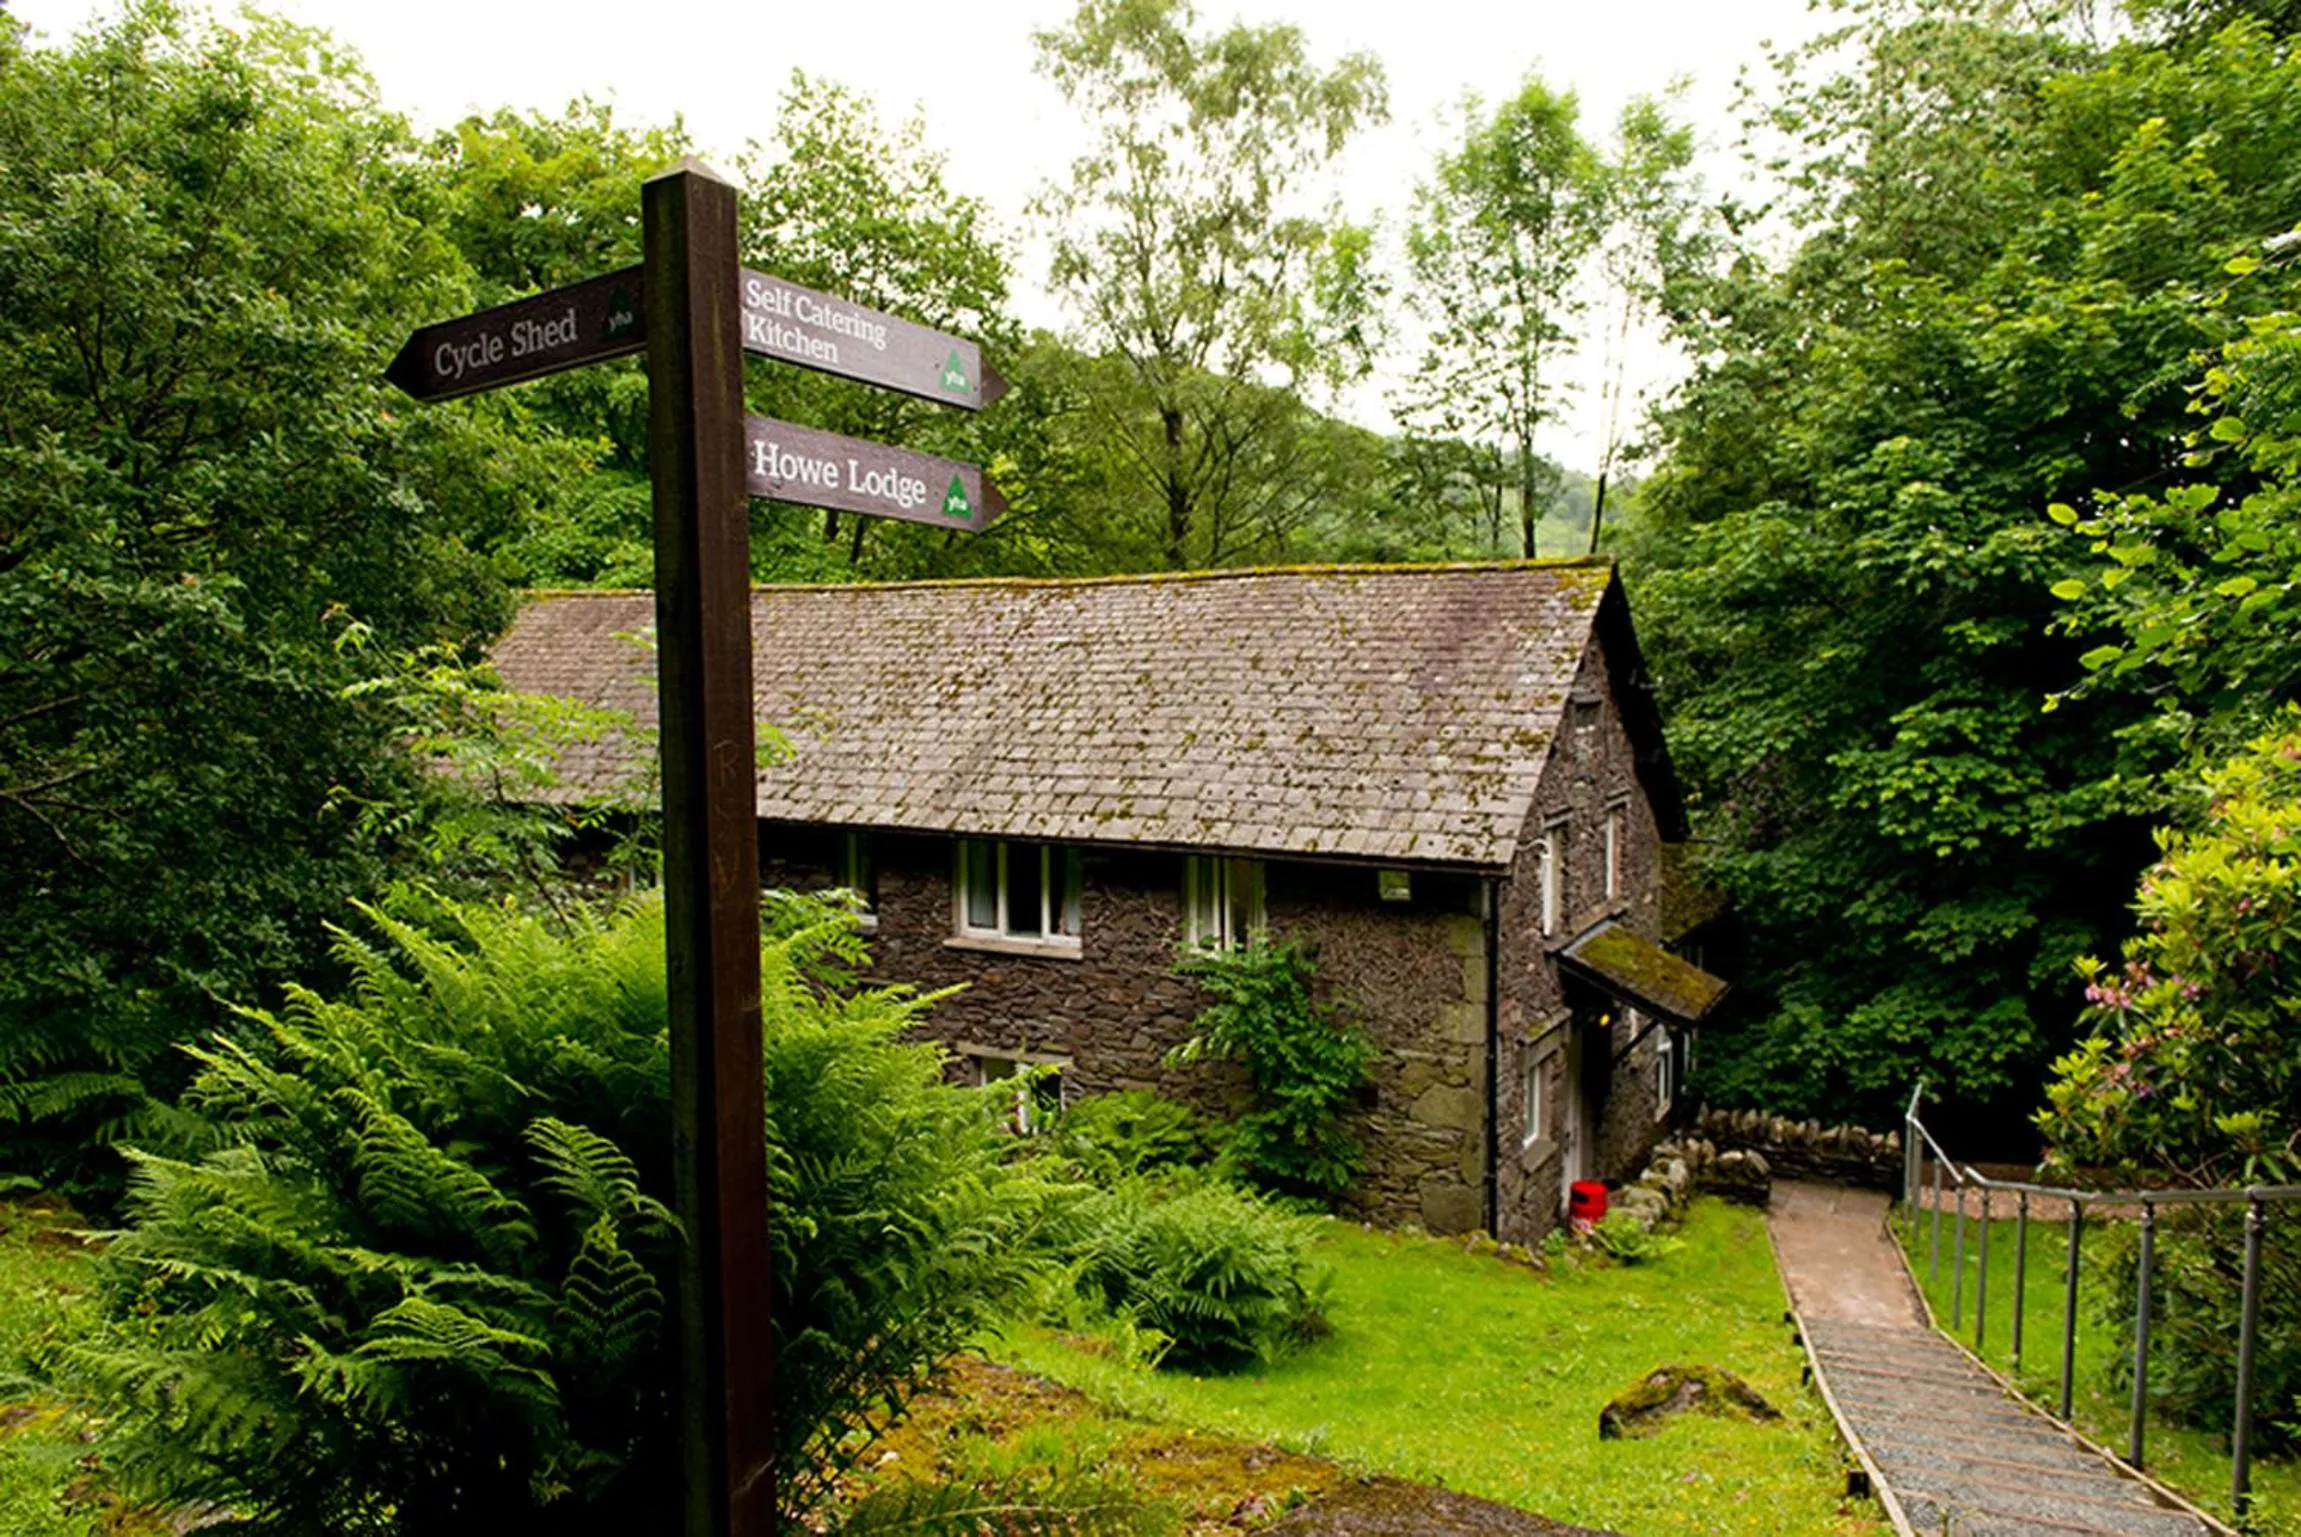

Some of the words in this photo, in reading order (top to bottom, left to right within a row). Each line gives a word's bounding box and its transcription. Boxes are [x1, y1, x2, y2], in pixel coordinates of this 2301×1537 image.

[434, 332, 504, 380] Cycle
[510, 308, 578, 358] Shed
[746, 279, 794, 317] Self
[795, 296, 887, 350] Catering
[747, 313, 838, 363] Kitchen
[753, 440, 839, 489] Howe
[848, 459, 926, 508] Lodge
